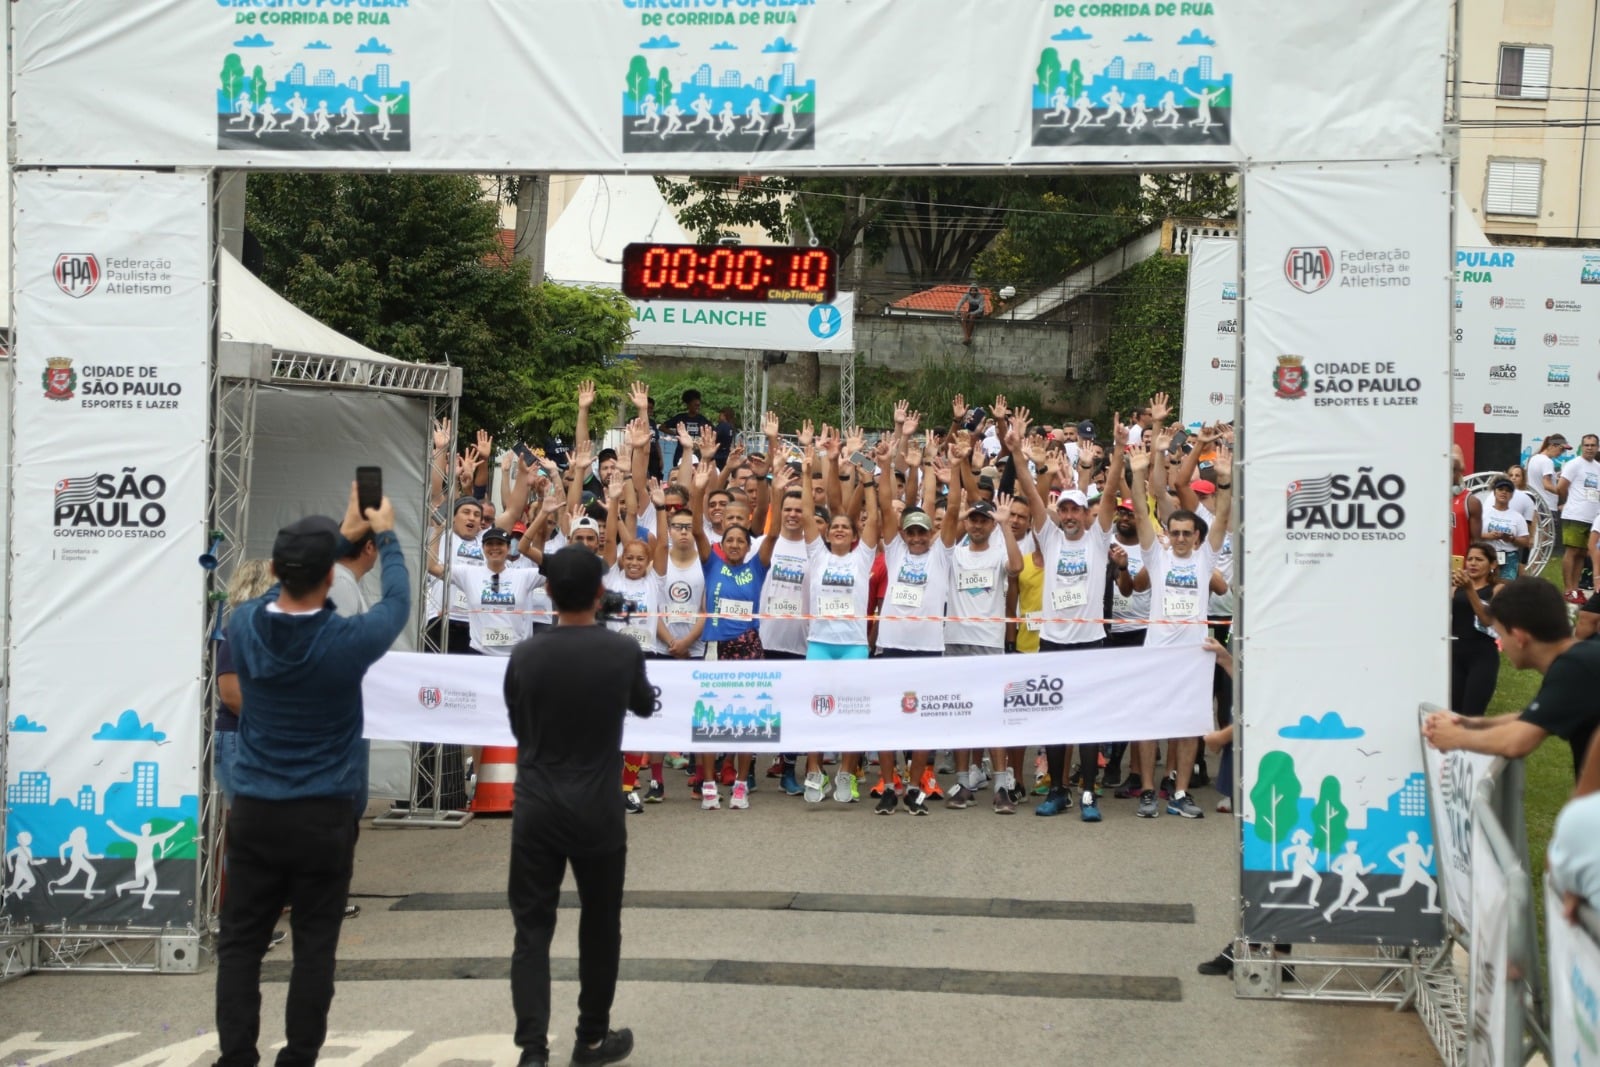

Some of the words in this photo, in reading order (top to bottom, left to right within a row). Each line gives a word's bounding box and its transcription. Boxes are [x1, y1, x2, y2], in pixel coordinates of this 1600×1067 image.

[1079, 3, 1150, 17] CORRIDA
[1181, 2, 1214, 16] RUA
[259, 11, 329, 25] CORRIDA
[357, 11, 390, 25] RUA
[666, 11, 735, 25] CORRIDA
[764, 11, 797, 24] RUA
[1340, 249, 1411, 262] Federação
[106, 257, 172, 270] Federação
[642, 248, 828, 291] 00:00:10
[1293, 252, 1325, 285] FPA
[1340, 263, 1394, 274] Paulista
[1398, 263, 1410, 272] de
[62, 258, 91, 290] FPA
[106, 270, 157, 281] Paulista
[160, 273, 171, 281] de
[1463, 271, 1492, 283] RUA
[1340, 276, 1411, 287] Atletismo
[106, 283, 172, 295] Atletismo
[768, 290, 824, 302] ChipTiming
[664, 308, 675, 323] E
[682, 308, 767, 327] LANCHE
[82, 366, 134, 378] CIDADE
[139, 366, 158, 378] DE
[1314, 362, 1370, 375] CIDADE
[1375, 362, 1396, 374] DE
[81, 378, 119, 395] SÃO
[123, 382, 181, 396] PAULO
[1314, 376, 1354, 393] SÃO
[1358, 377, 1421, 392] PAULO
[82, 400, 133, 408] ESPORTES
[137, 400, 142, 408] E
[146, 400, 179, 409] LAZER
[1314, 397, 1369, 406] ESPORTES
[1373, 397, 1379, 406] E
[1383, 397, 1418, 406] LAZER
[96, 466, 166, 500] SÃO
[1331, 466, 1406, 501] SÃO
[54, 502, 166, 527] PAULO
[1286, 503, 1406, 529] PAULO
[54, 529, 105, 538] GOVERNO
[107, 530, 123, 538] DO
[125, 530, 166, 538] ESTADO
[1286, 532, 1341, 541] GOVERNO
[1343, 532, 1359, 541] DO
[1362, 532, 1406, 541] ESTADO
[965, 576, 988, 584] 10045
[895, 592, 917, 601] 10850
[726, 606, 748, 614] 10230
[774, 603, 797, 611] 10496
[692, 670, 736, 680] CIRCUITO
[738, 671, 782, 680] POPULAR
[1026, 675, 1064, 692] SÃO
[422, 689, 437, 705] FPA
[1003, 692, 1063, 707] PAULO
[815, 697, 831, 713] FPA
[921, 702, 941, 710] SÃO
[943, 701, 973, 709] PAULO
